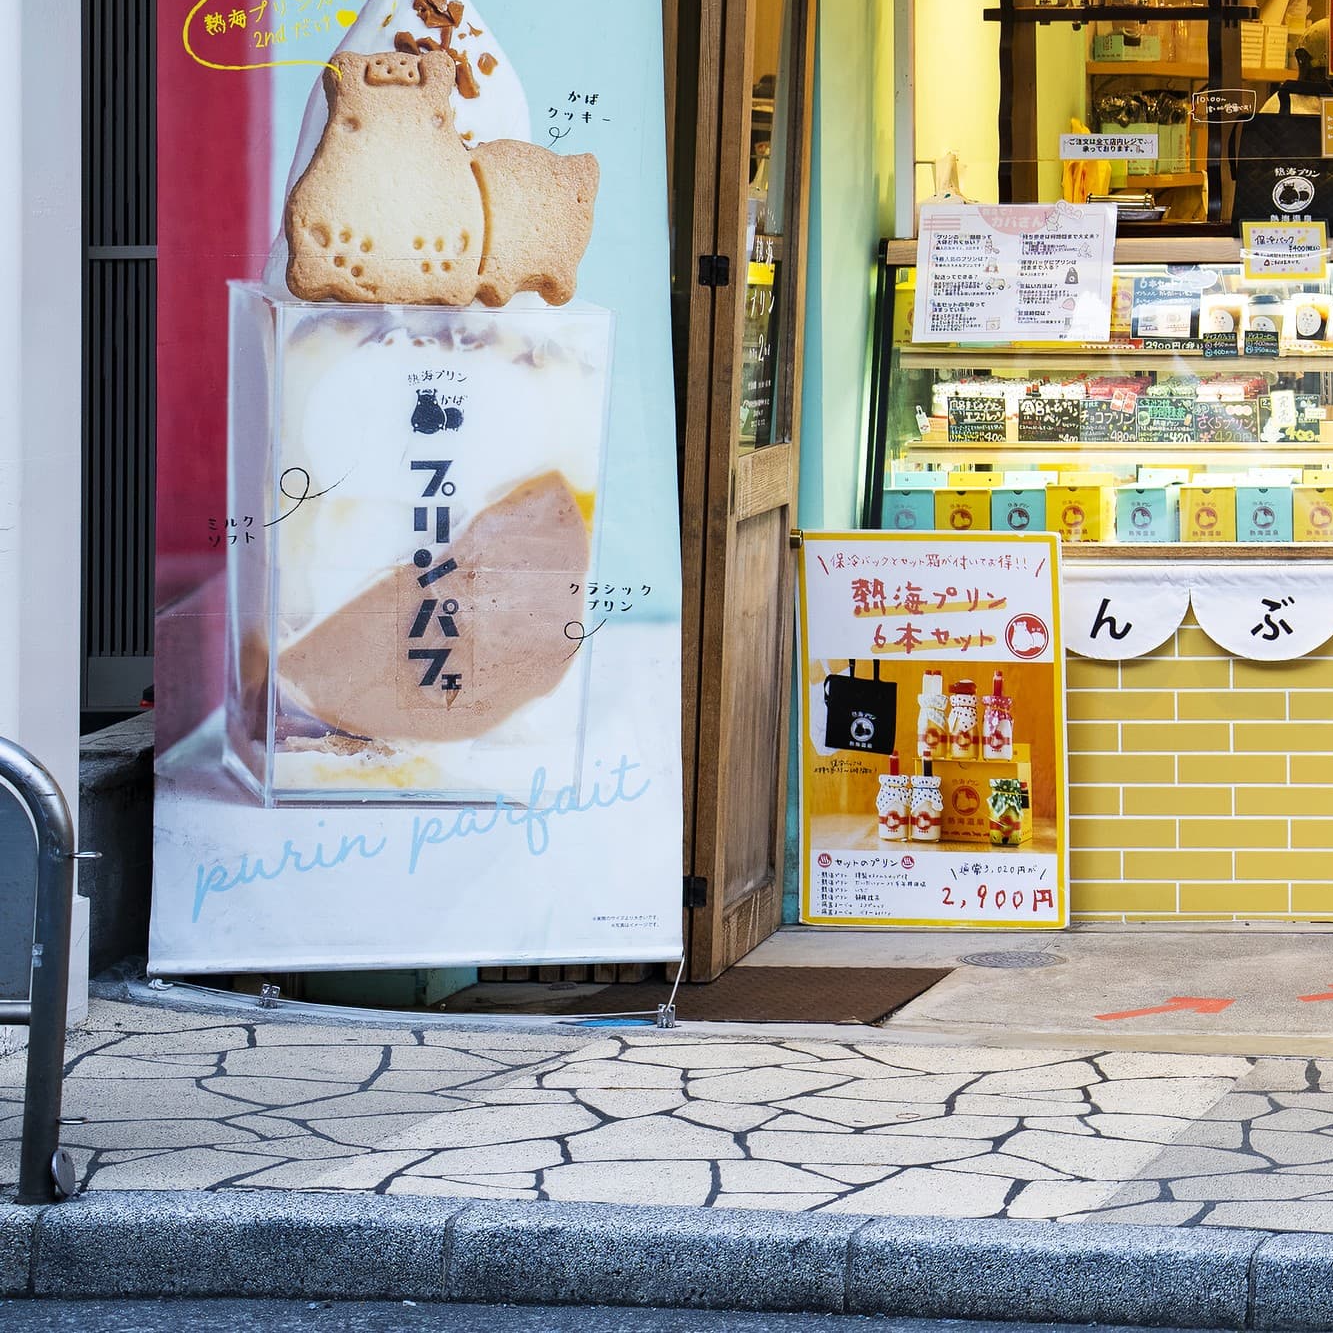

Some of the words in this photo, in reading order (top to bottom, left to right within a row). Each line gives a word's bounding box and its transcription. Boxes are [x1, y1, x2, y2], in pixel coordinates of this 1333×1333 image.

[567, 91, 600, 107] かば
[547, 108, 612, 124] クッキー
[208, 515, 254, 531] ミルク
[208, 531, 255, 548] ソフト
[409, 459, 465, 692] プリンパフェ
[569, 582, 652, 596] クラシック
[852, 578, 1008, 616] 熱海プリン
[587, 599, 634, 612] プリン
[873, 621, 994, 654] 6本セット
[190, 831, 387, 922] purin
[407, 753, 652, 876] parfait
[941, 884, 1054, 913] 2,900円
